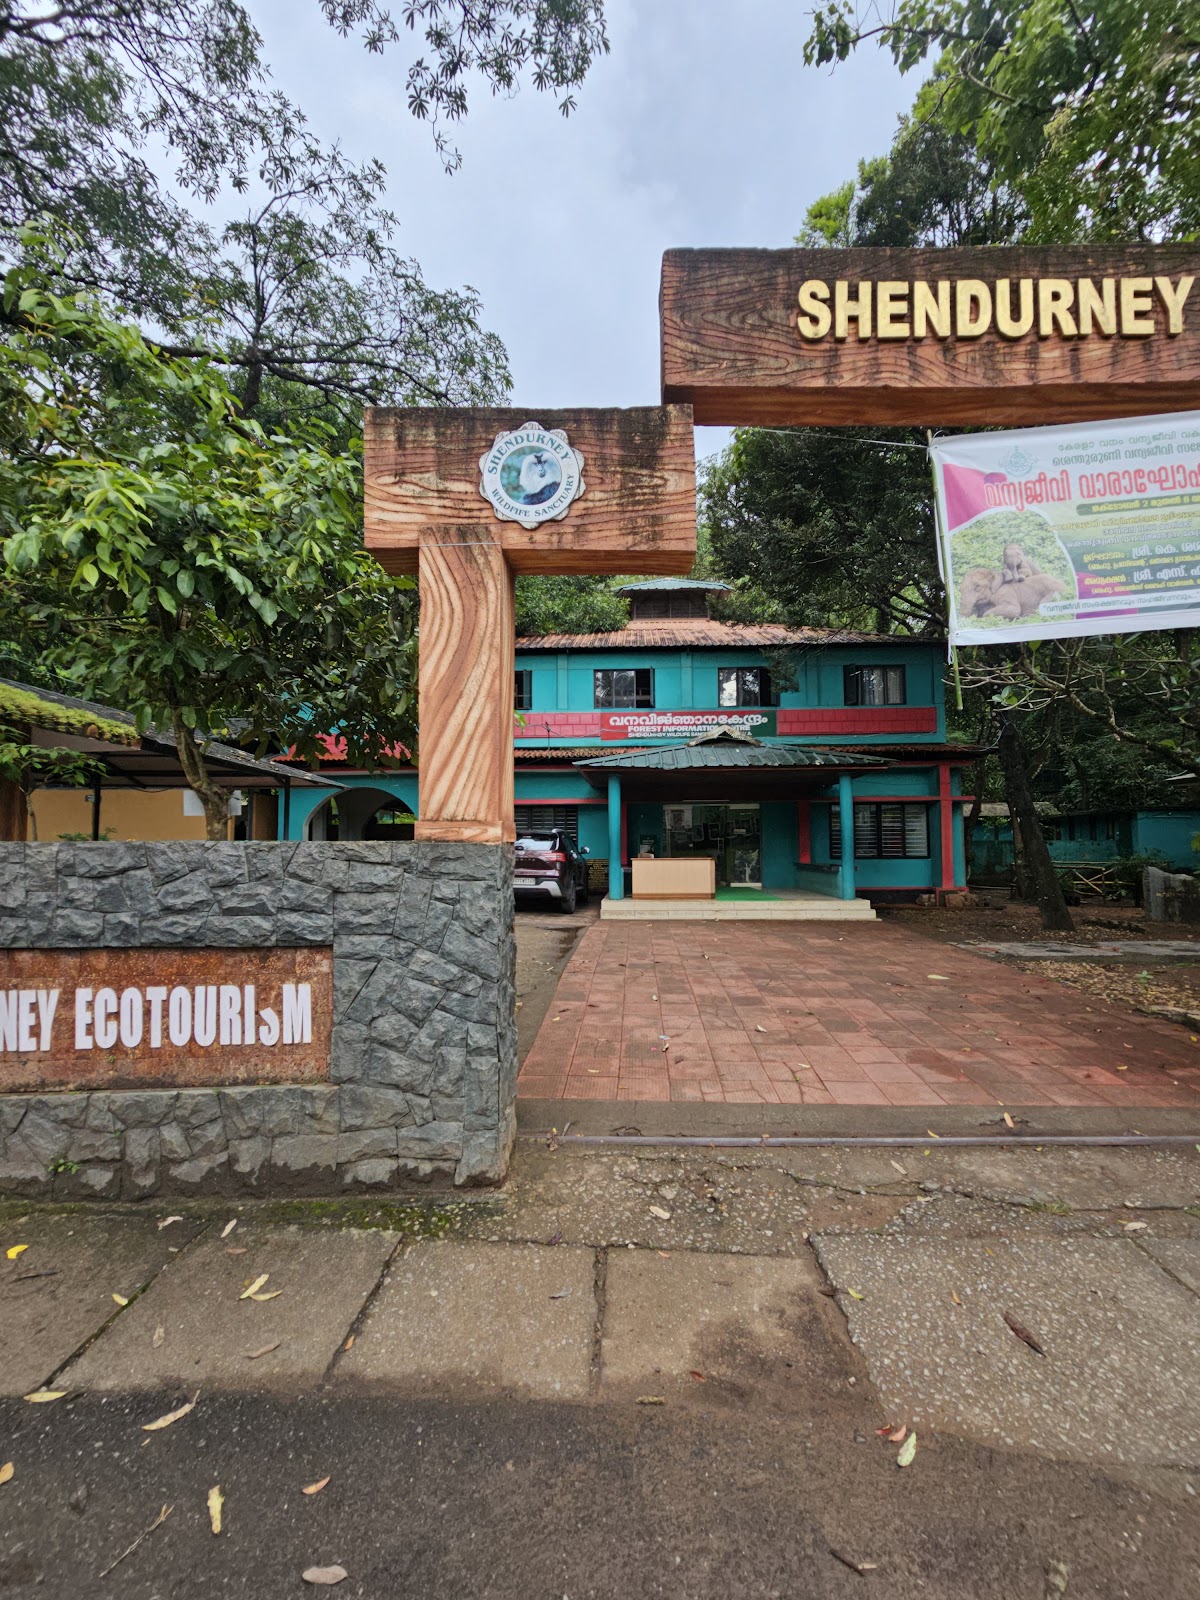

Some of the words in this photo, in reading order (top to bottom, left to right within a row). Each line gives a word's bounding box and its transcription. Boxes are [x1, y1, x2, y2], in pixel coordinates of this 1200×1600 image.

[797, 275, 1194, 340] SHENDURNEY
[488, 433, 571, 475] SHENDURNEY
[534, 473, 575, 517] SANCTUARY
[983, 469, 1073, 513] വന്യജീവി
[628, 725, 662, 733] FOREST
[0, 989, 60, 1052] NEY
